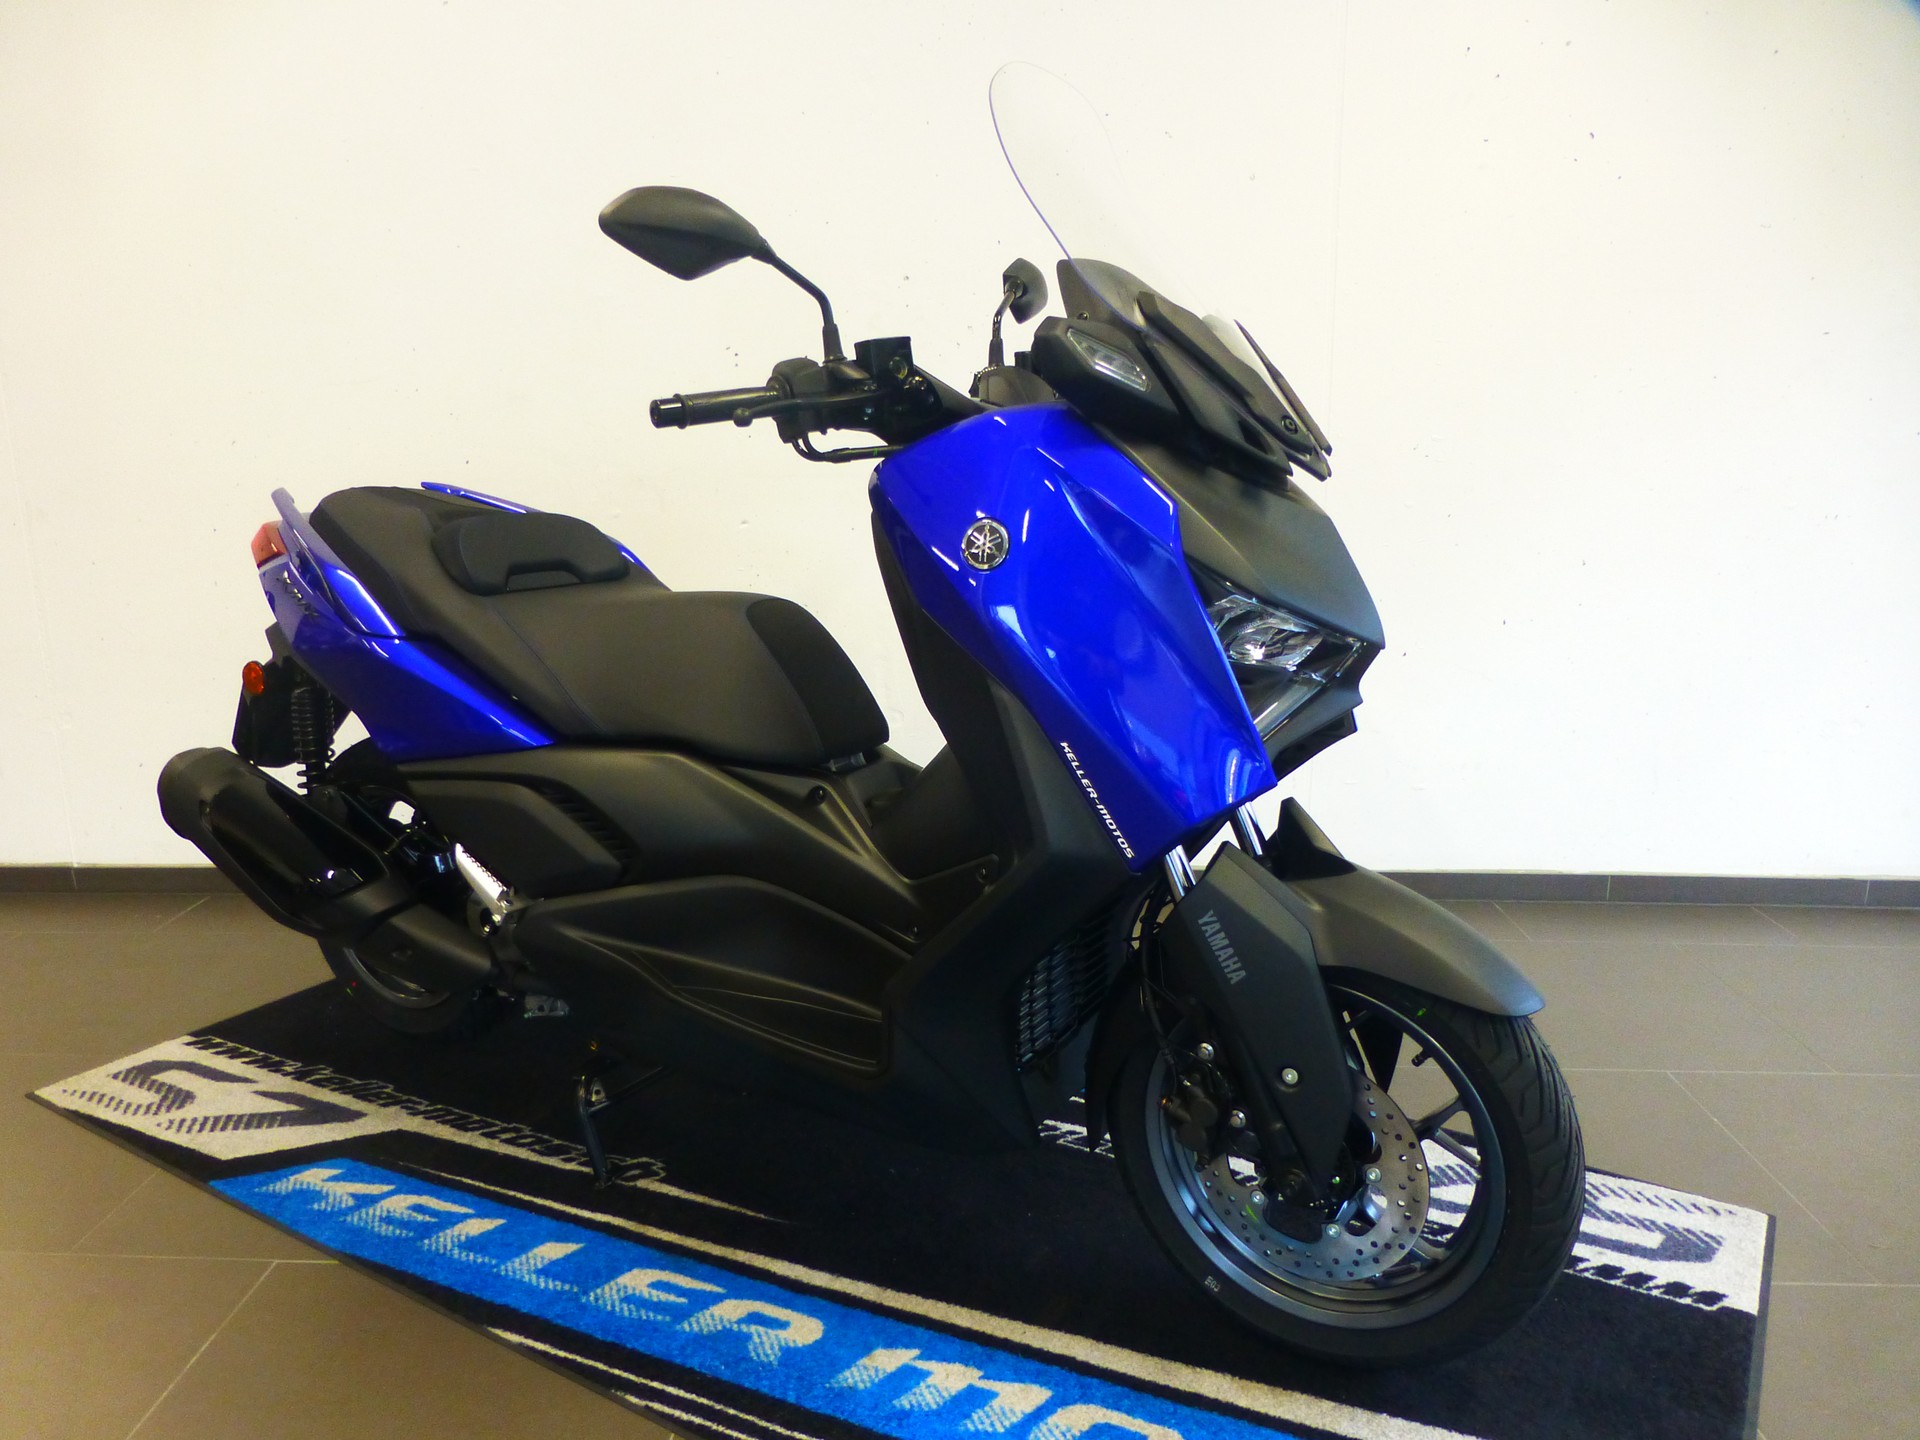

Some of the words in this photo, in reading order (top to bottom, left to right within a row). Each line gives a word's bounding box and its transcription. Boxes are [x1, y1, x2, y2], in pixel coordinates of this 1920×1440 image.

[1060, 741, 1135, 859] KELLER-MOTOS
[1198, 909, 1246, 985] YAMAHA
[183, 1036, 666, 1187] www.keller-motos.h
[253, 1167, 825, 1368] KELLER
